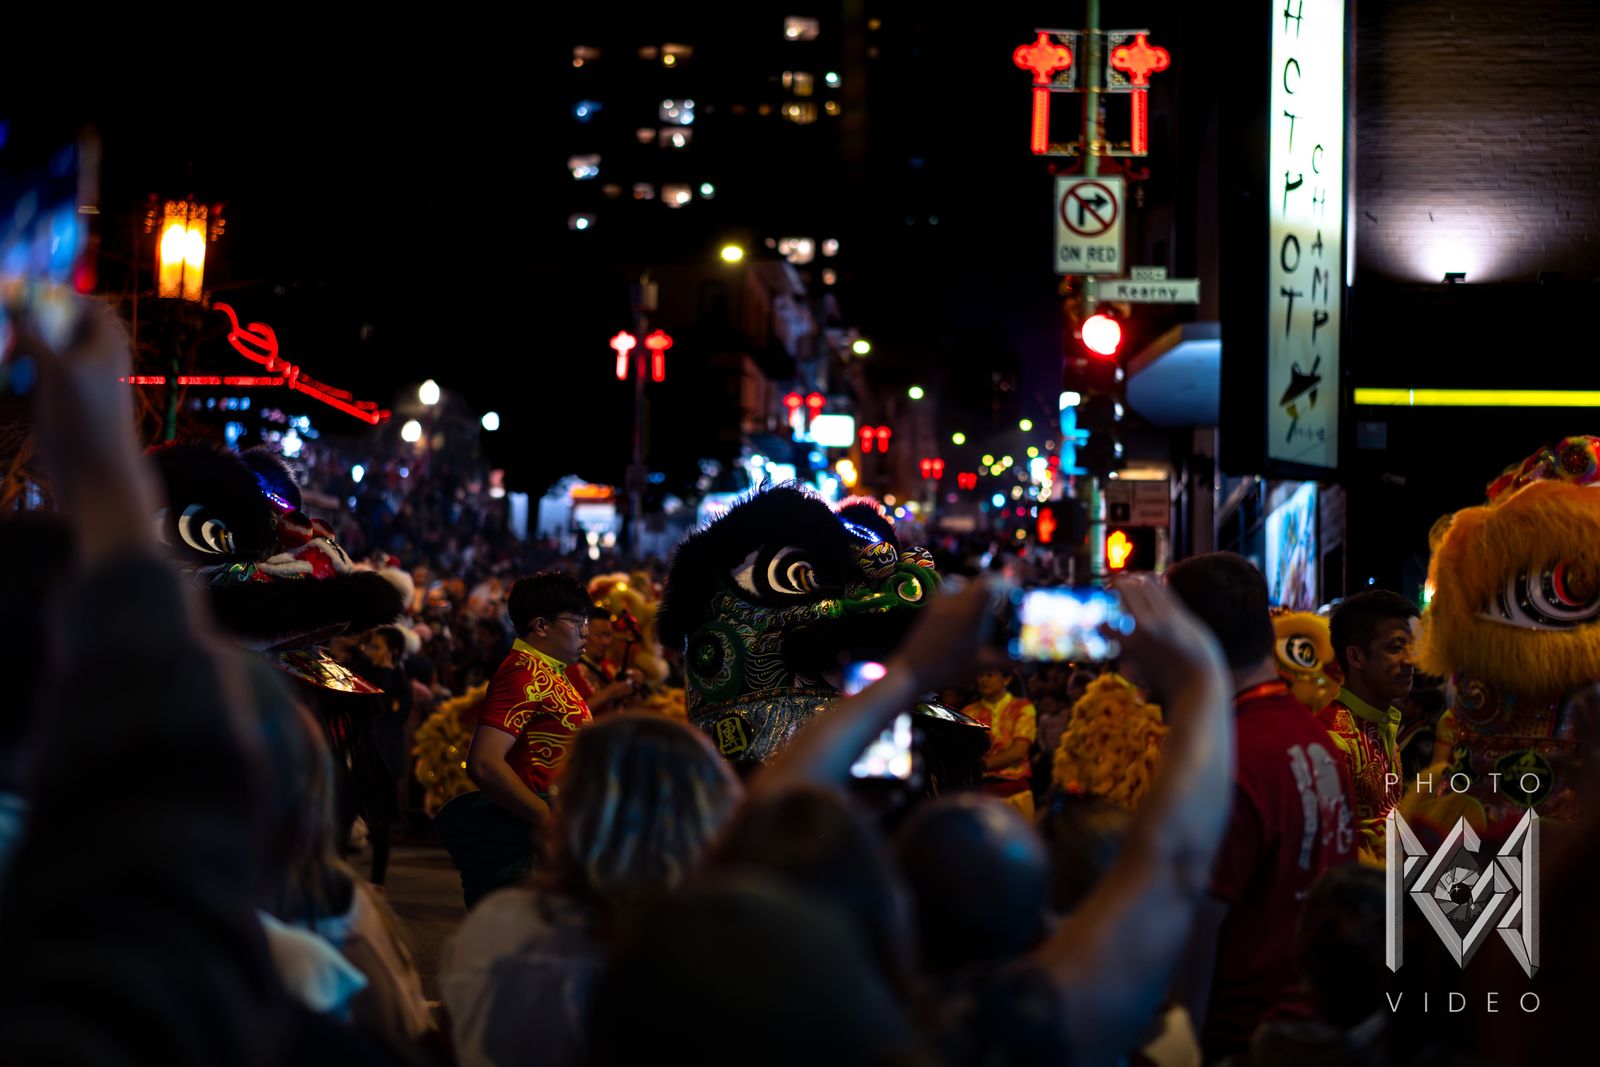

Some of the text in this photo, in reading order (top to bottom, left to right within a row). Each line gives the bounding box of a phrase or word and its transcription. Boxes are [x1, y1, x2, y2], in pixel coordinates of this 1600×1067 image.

[1311, 144, 1329, 345] CHAMP
[1060, 245, 1117, 262] ON RED
[1117, 286, 1178, 302] Kearny
